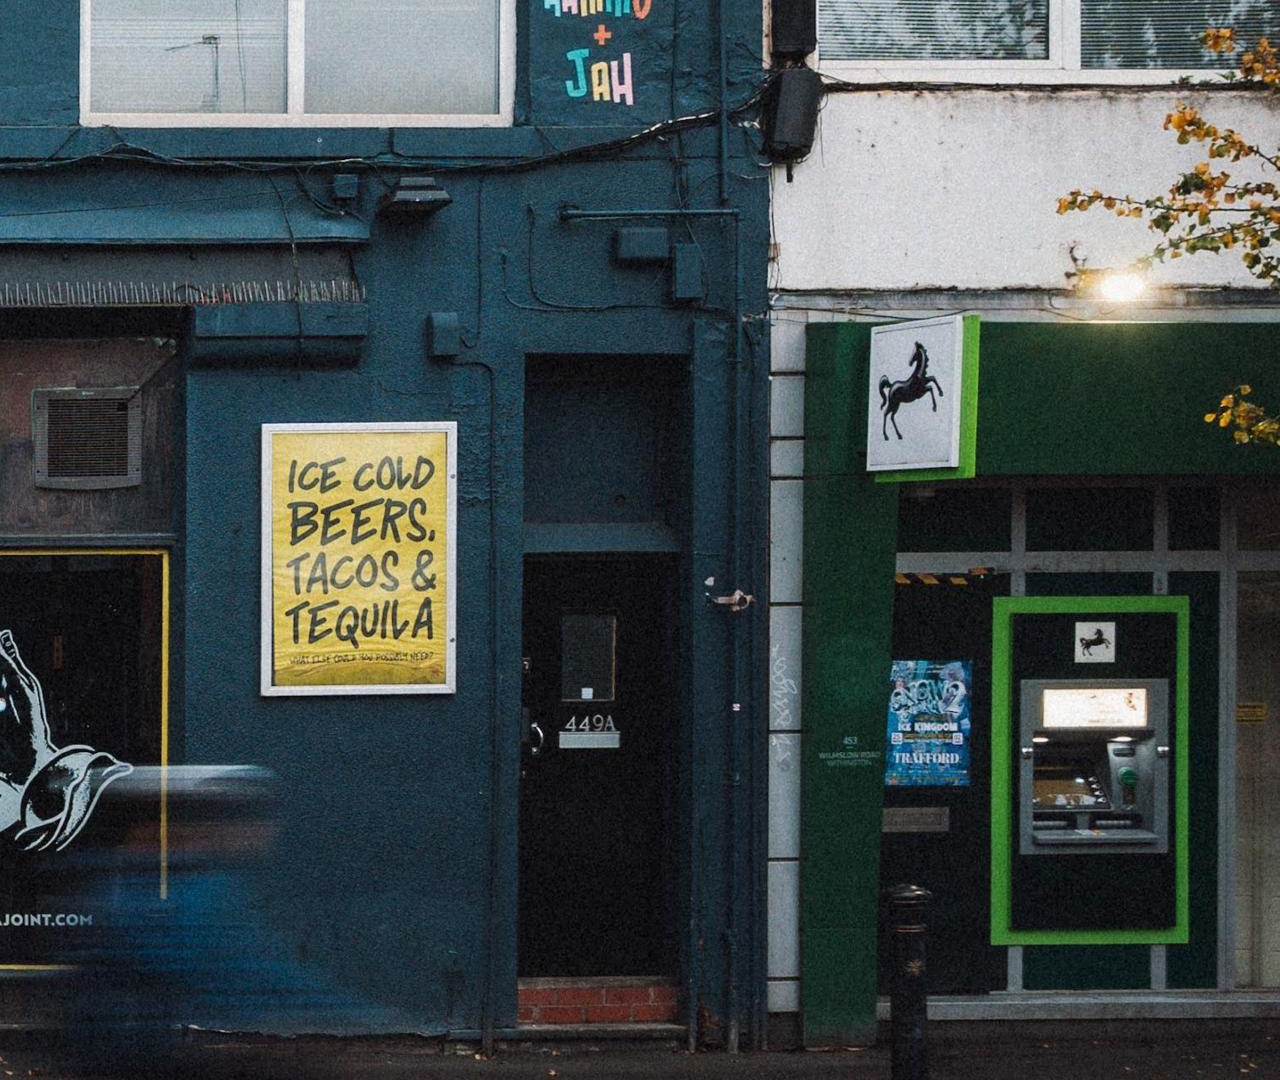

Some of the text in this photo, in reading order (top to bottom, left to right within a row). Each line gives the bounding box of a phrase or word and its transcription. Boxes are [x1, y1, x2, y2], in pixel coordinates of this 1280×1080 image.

[565, 48, 634, 106] JAH
[288, 455, 435, 493] ICE COLD
[286, 549, 437, 595] TACOS &
[285, 597, 434, 649] TEQUILA
[565, 714, 616, 732] 449A
[914, 722, 959, 731] KINGDOM
[895, 752, 960, 764] TRAFFORD
